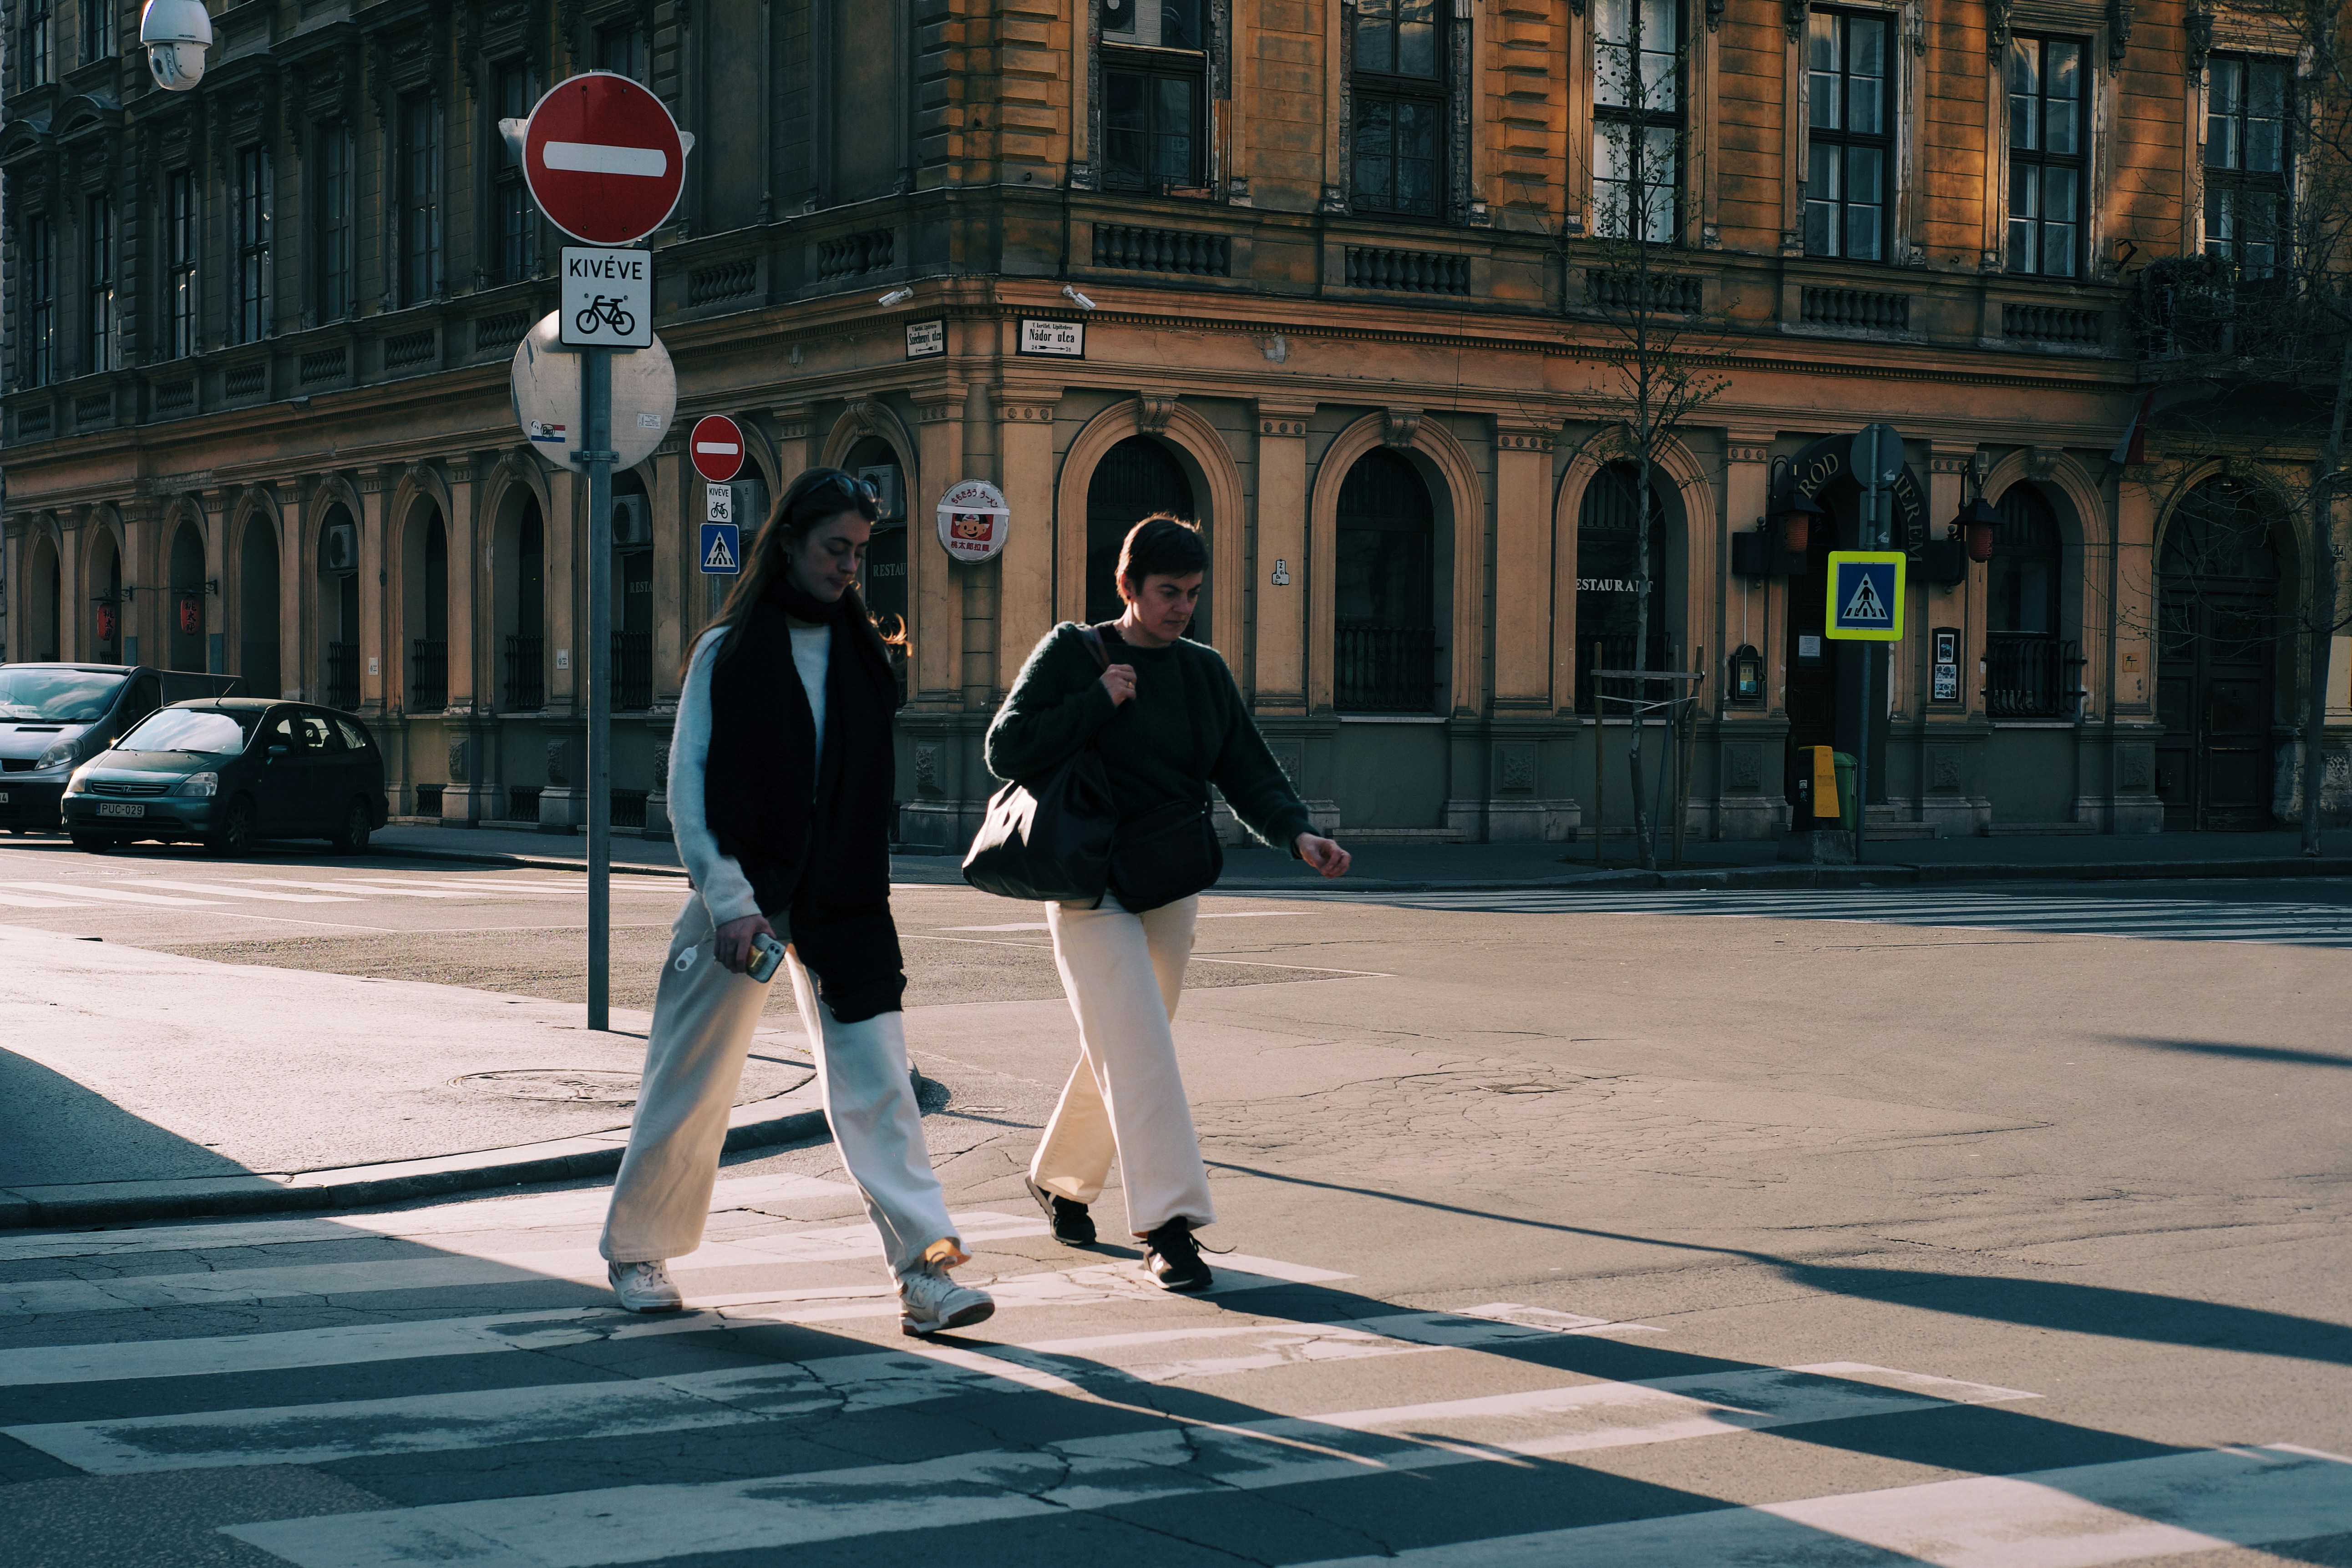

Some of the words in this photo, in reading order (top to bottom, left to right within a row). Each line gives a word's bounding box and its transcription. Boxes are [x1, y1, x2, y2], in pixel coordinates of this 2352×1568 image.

[570, 255, 642, 280] KIVÉVE
[909, 332, 930, 346] Széchenyi
[932, 329, 942, 341] utca
[1029, 329, 1052, 341] Nádor
[1058, 331, 1075, 343] utca
[709, 486, 729, 497] KIVÉVE
[873, 563, 907, 577] RESTAU
[630, 581, 653, 593] RESTA
[103, 609, 114, 637] 桃太郎
[185, 602, 197, 632] 桃太郎
[0, 794, 7, 802] 4
[102, 804, 142, 815] PUC-029
